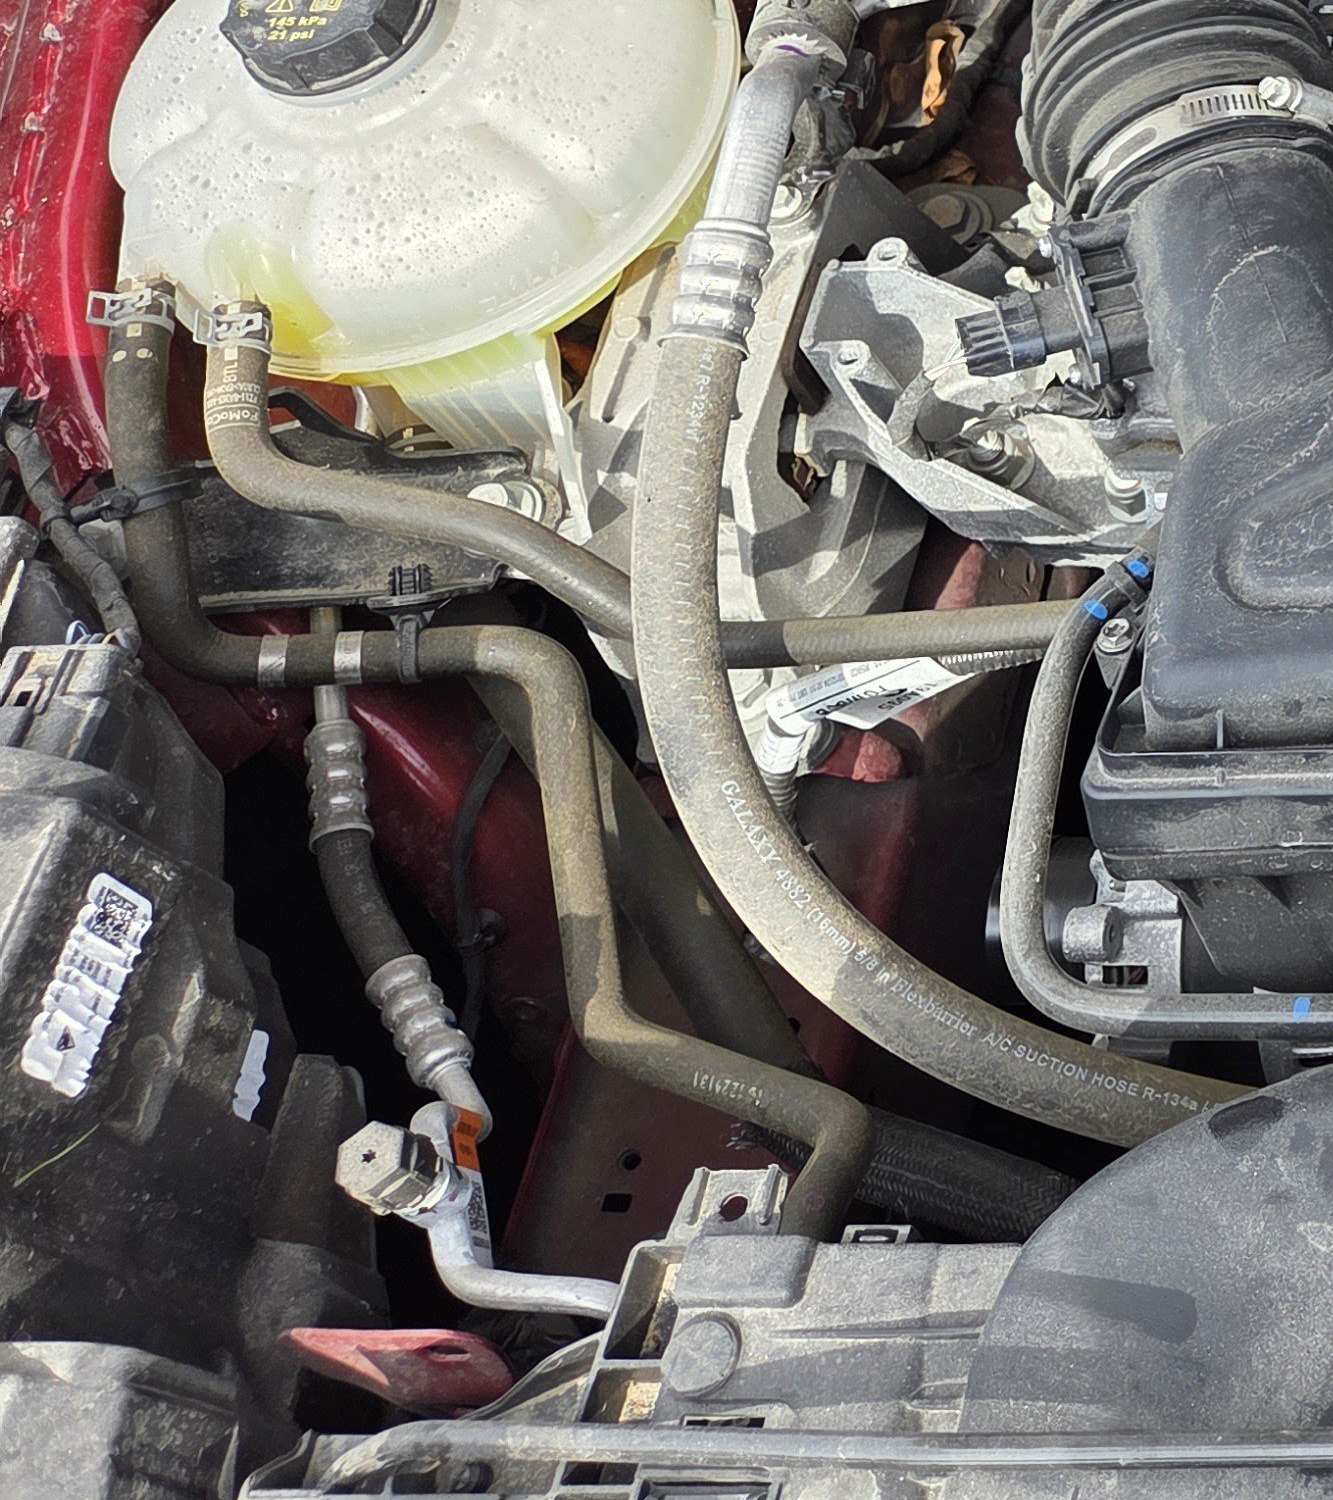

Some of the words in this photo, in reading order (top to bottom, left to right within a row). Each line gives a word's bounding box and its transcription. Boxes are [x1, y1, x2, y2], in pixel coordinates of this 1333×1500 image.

[268, 17, 297, 28] 145
[298, 16, 327, 26] kPa
[268, 30, 287, 40] 21
[289, 29, 315, 42] psi
[207, 409, 259, 425] FoMoCo
[722, 781, 781, 865] GALAXY
[774, 867, 814, 911] 4882
[807, 905, 857, 957] (16mm)
[854, 951, 877, 973] 5/8
[892, 977, 979, 1038] Flexbarrier
[982, 1031, 1013, 1054] A/C
[1013, 1044, 1089, 1083] SUCTION
[1091, 1071, 1139, 1097] HOSE
[1142, 1087, 1199, 1112] R-134a
